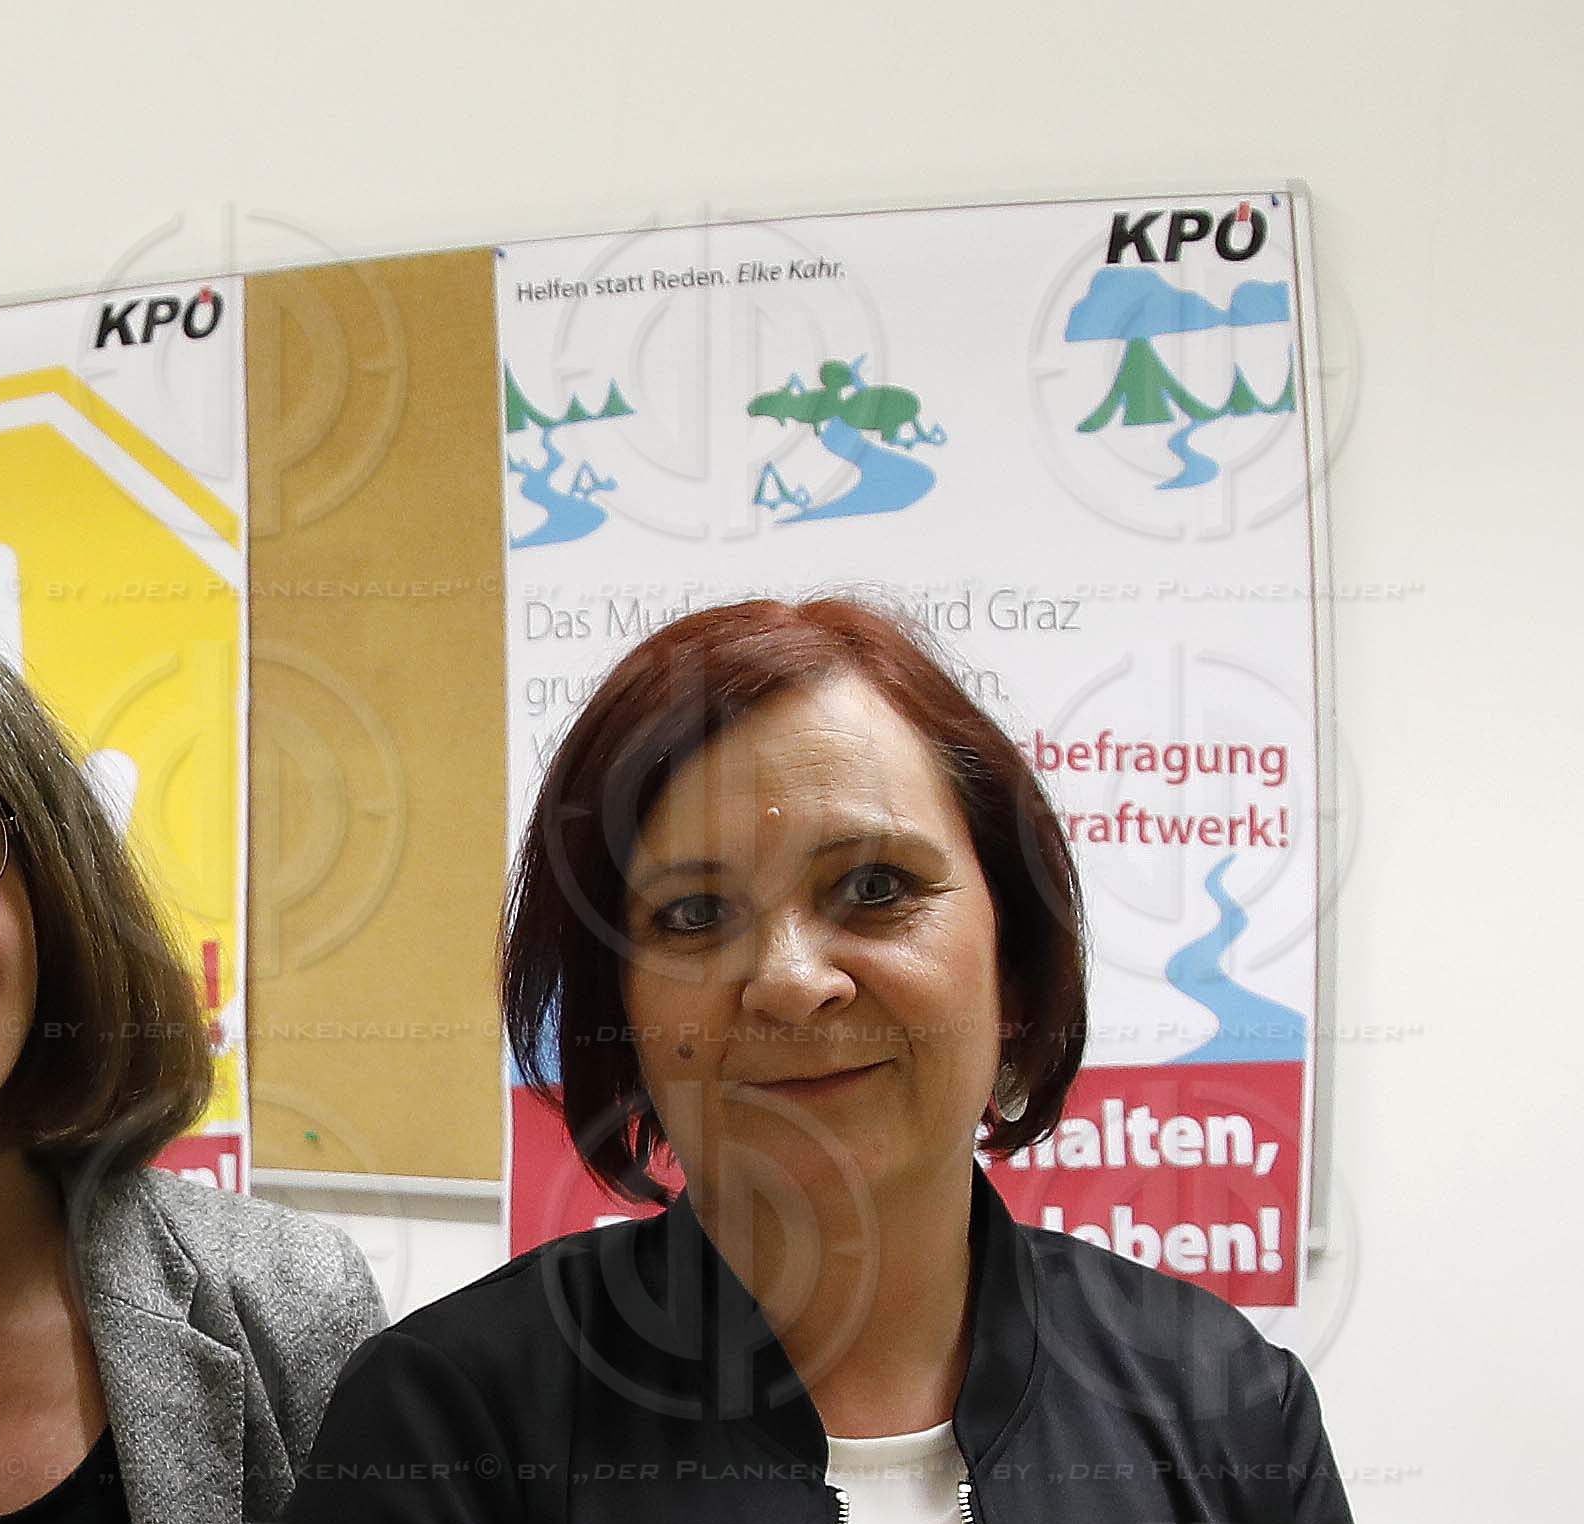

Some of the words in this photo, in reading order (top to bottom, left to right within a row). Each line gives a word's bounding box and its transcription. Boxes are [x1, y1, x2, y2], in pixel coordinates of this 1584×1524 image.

[1106, 201, 1266, 264] KPÖ
[517, 279, 588, 302] Helfen
[594, 274, 644, 296] statt
[652, 265, 730, 291] Reden.
[737, 260, 784, 283] Elke
[789, 255, 847, 281] Kahr.
[95, 287, 223, 348] KPÖ
[526, 600, 591, 641] Das
[913, 590, 972, 631] ird
[988, 589, 1081, 631] Graz
[1057, 801, 1289, 848] raftwerk!
